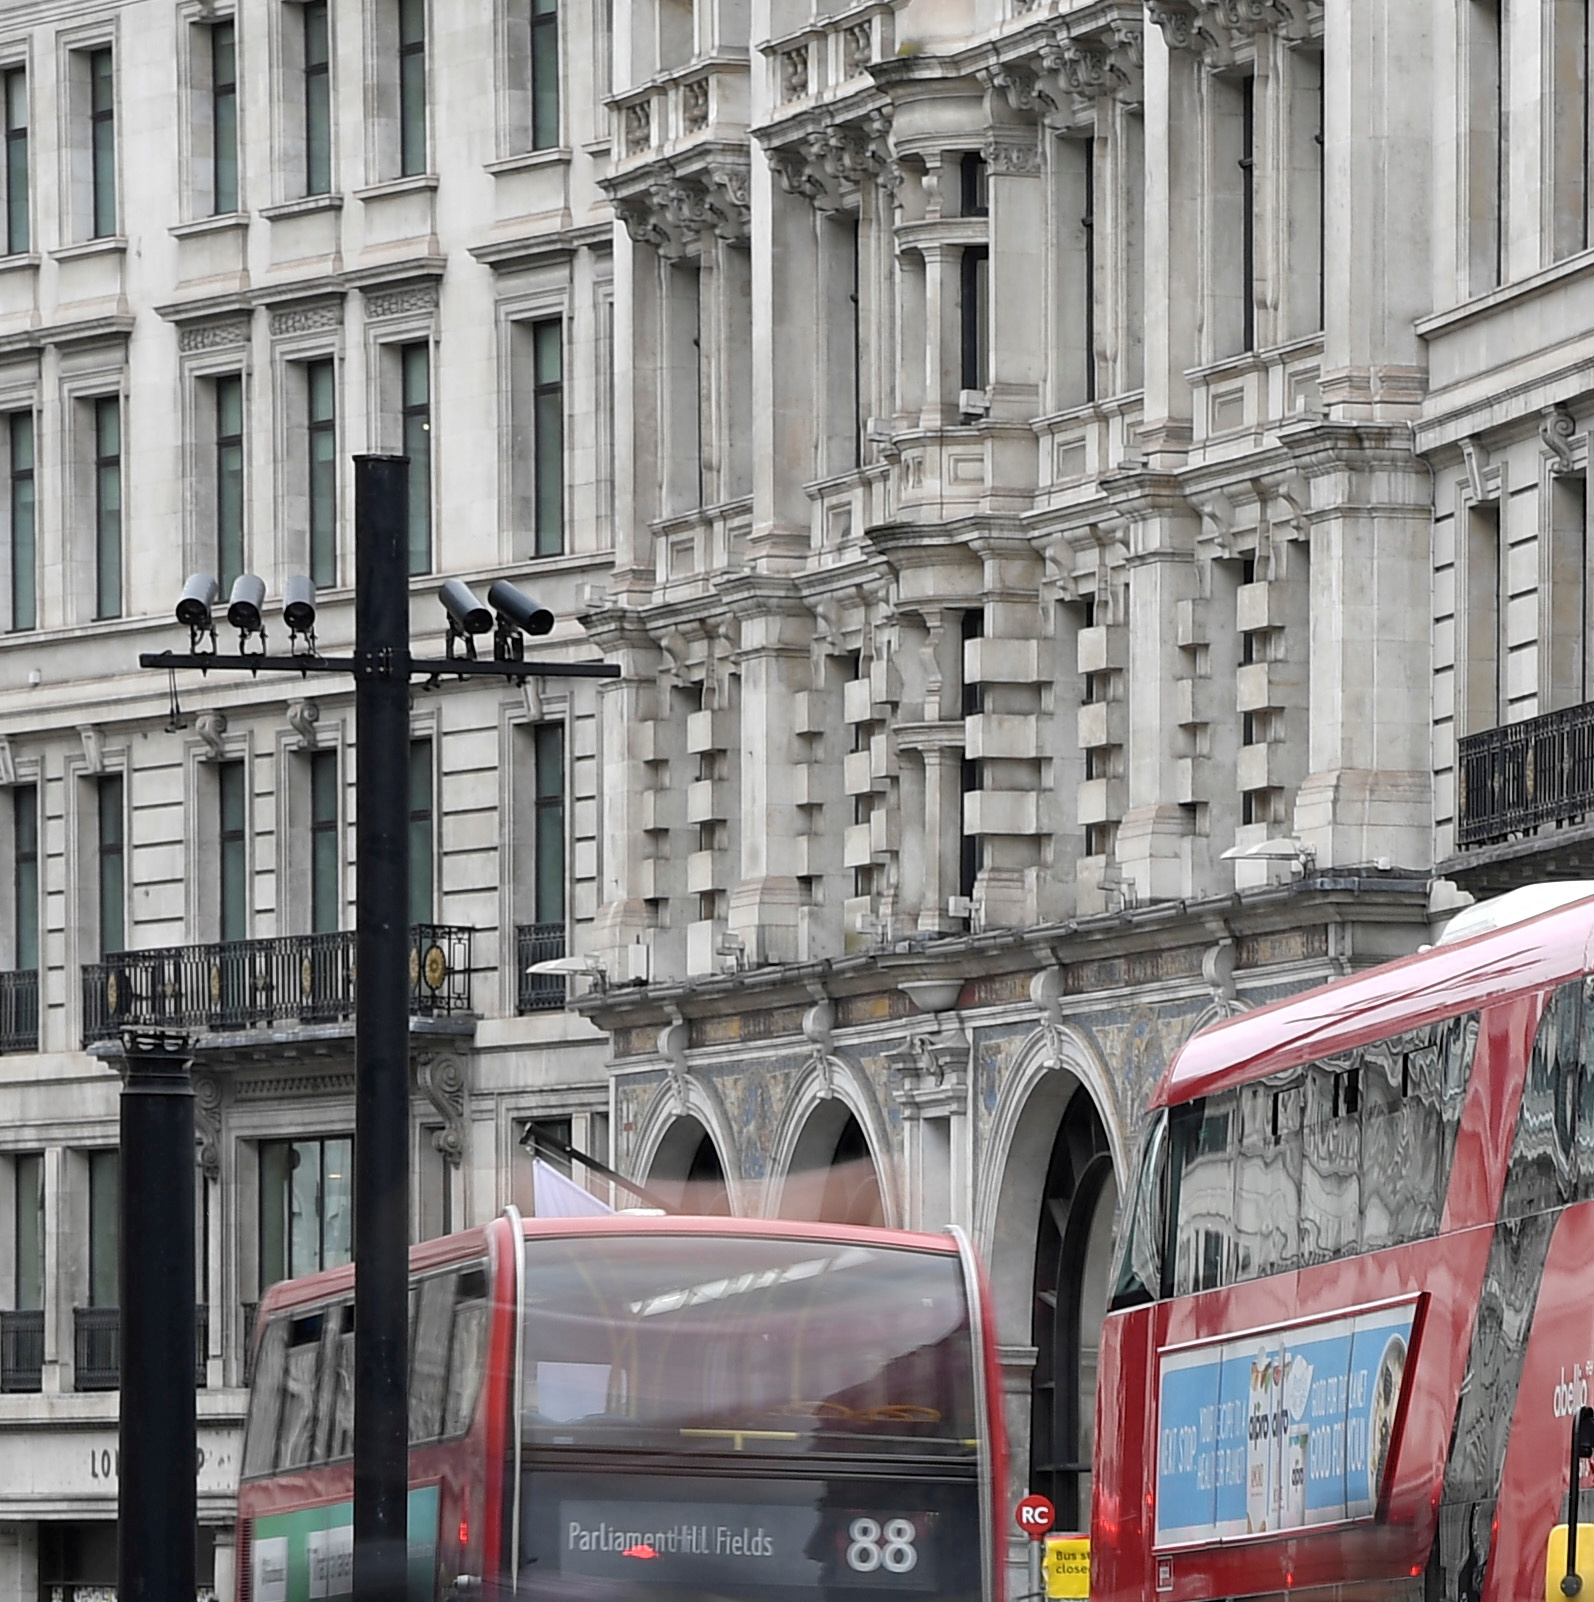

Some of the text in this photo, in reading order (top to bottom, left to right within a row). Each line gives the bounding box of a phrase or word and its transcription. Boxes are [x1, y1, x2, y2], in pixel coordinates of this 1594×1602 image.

[1021, 1506, 1049, 1524] RC
[716, 1525, 774, 1557] Fields
[845, 1517, 918, 1573] 88
[1056, 1550, 1078, 1561] Bus
